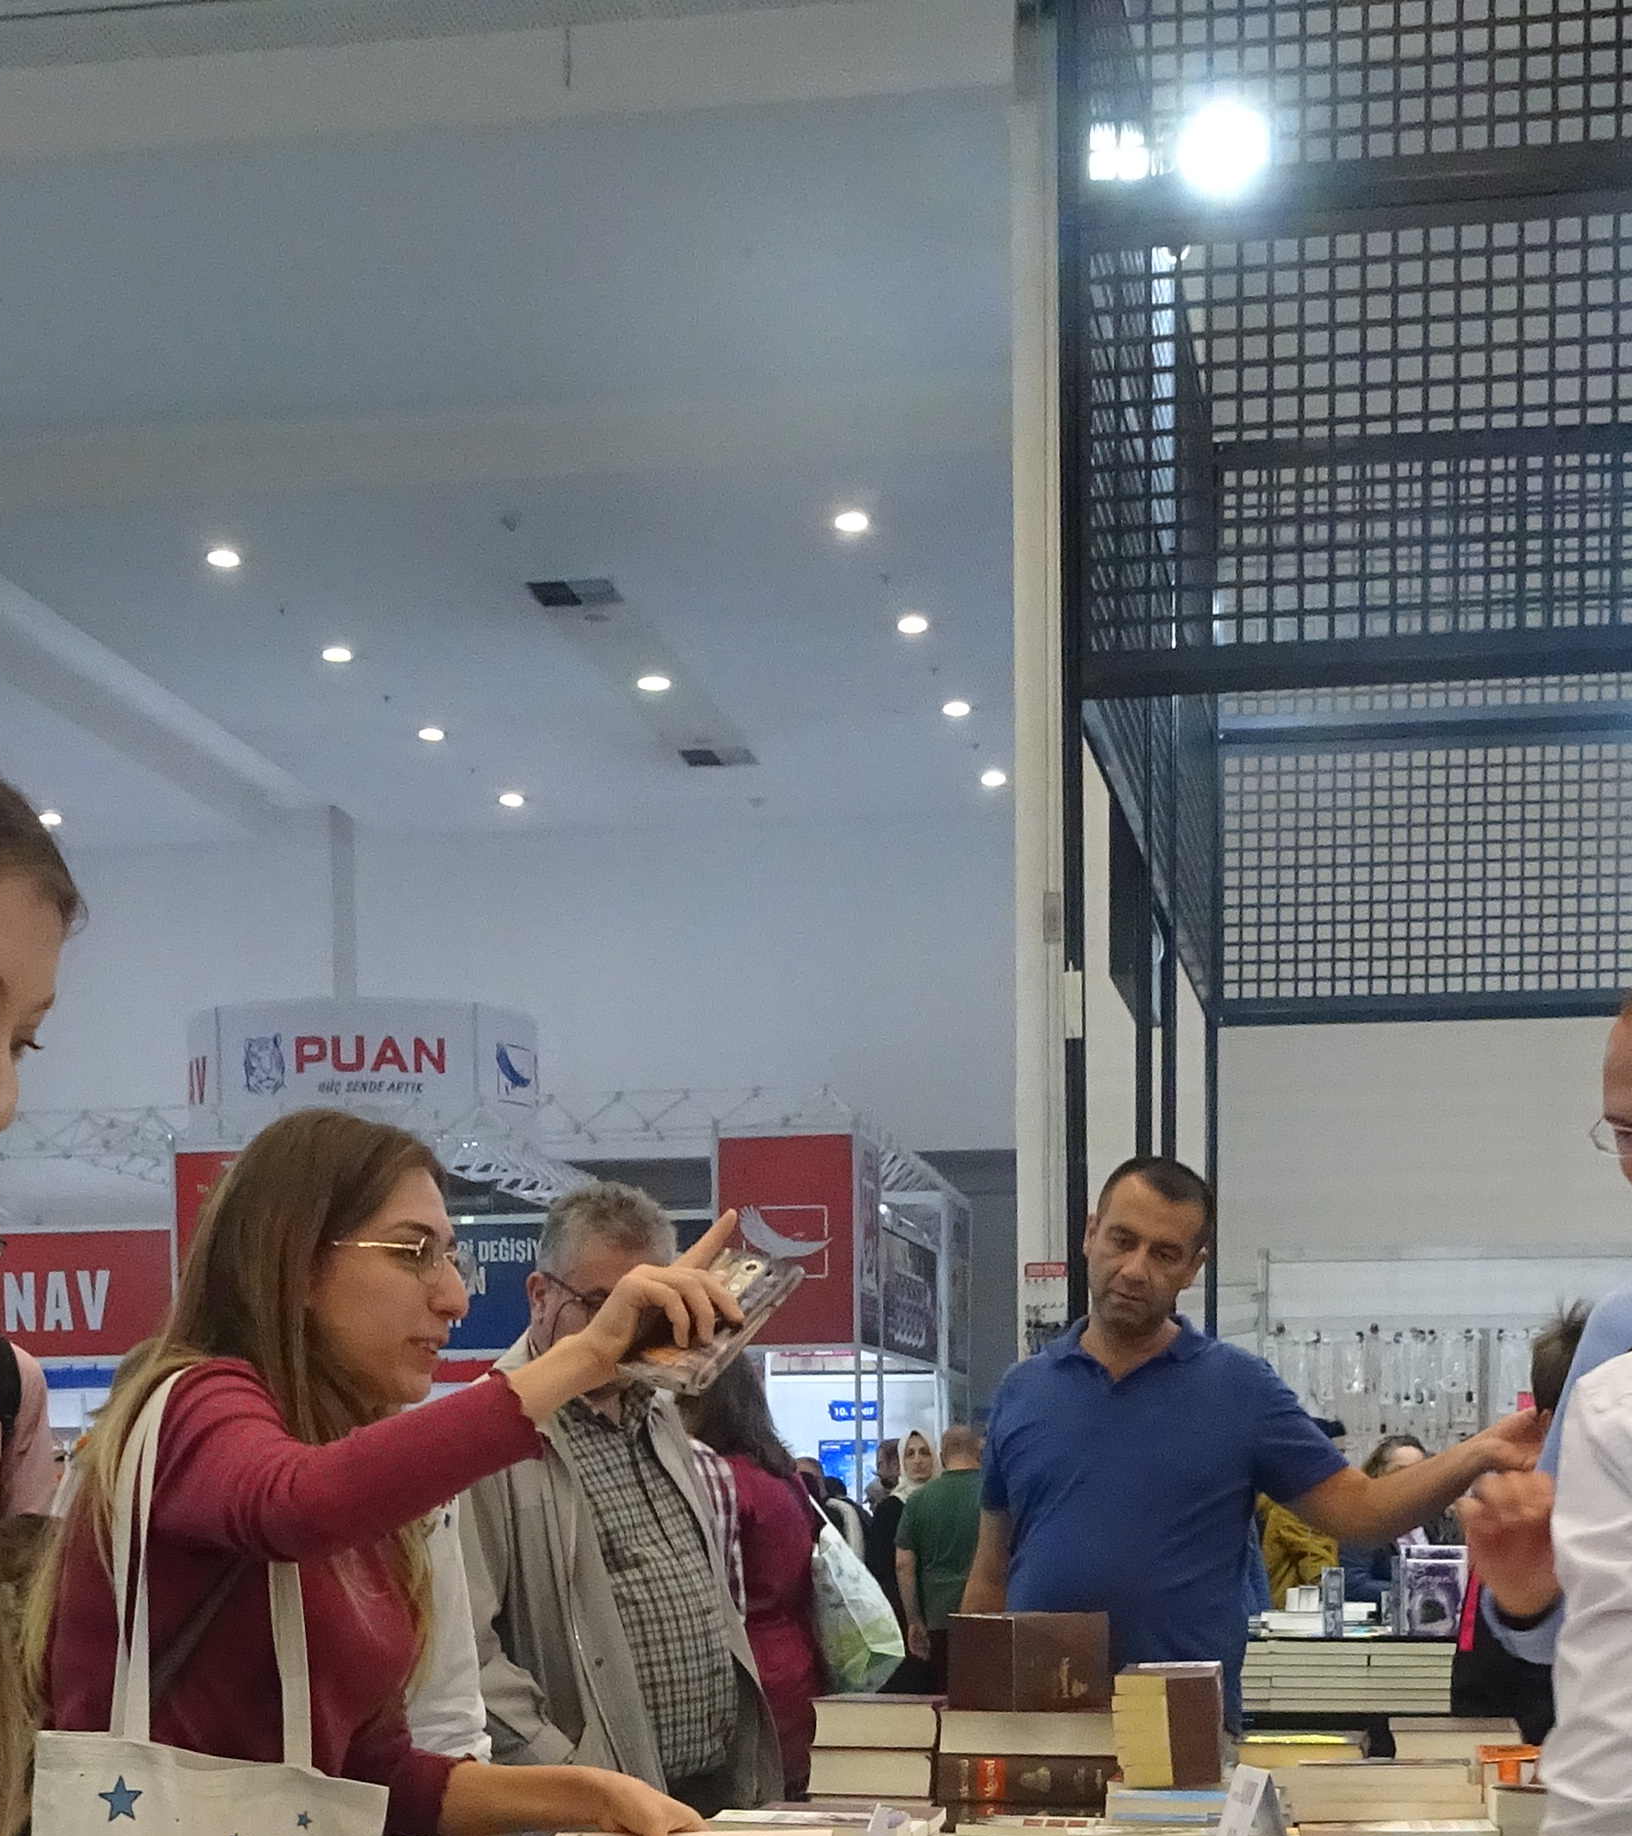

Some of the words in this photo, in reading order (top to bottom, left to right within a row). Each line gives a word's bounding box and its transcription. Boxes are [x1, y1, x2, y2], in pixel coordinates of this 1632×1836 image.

[294, 1034, 446, 1075] PUAN
[345, 1079, 385, 1095] SENDE
[386, 1080, 425, 1095] ARTIK
